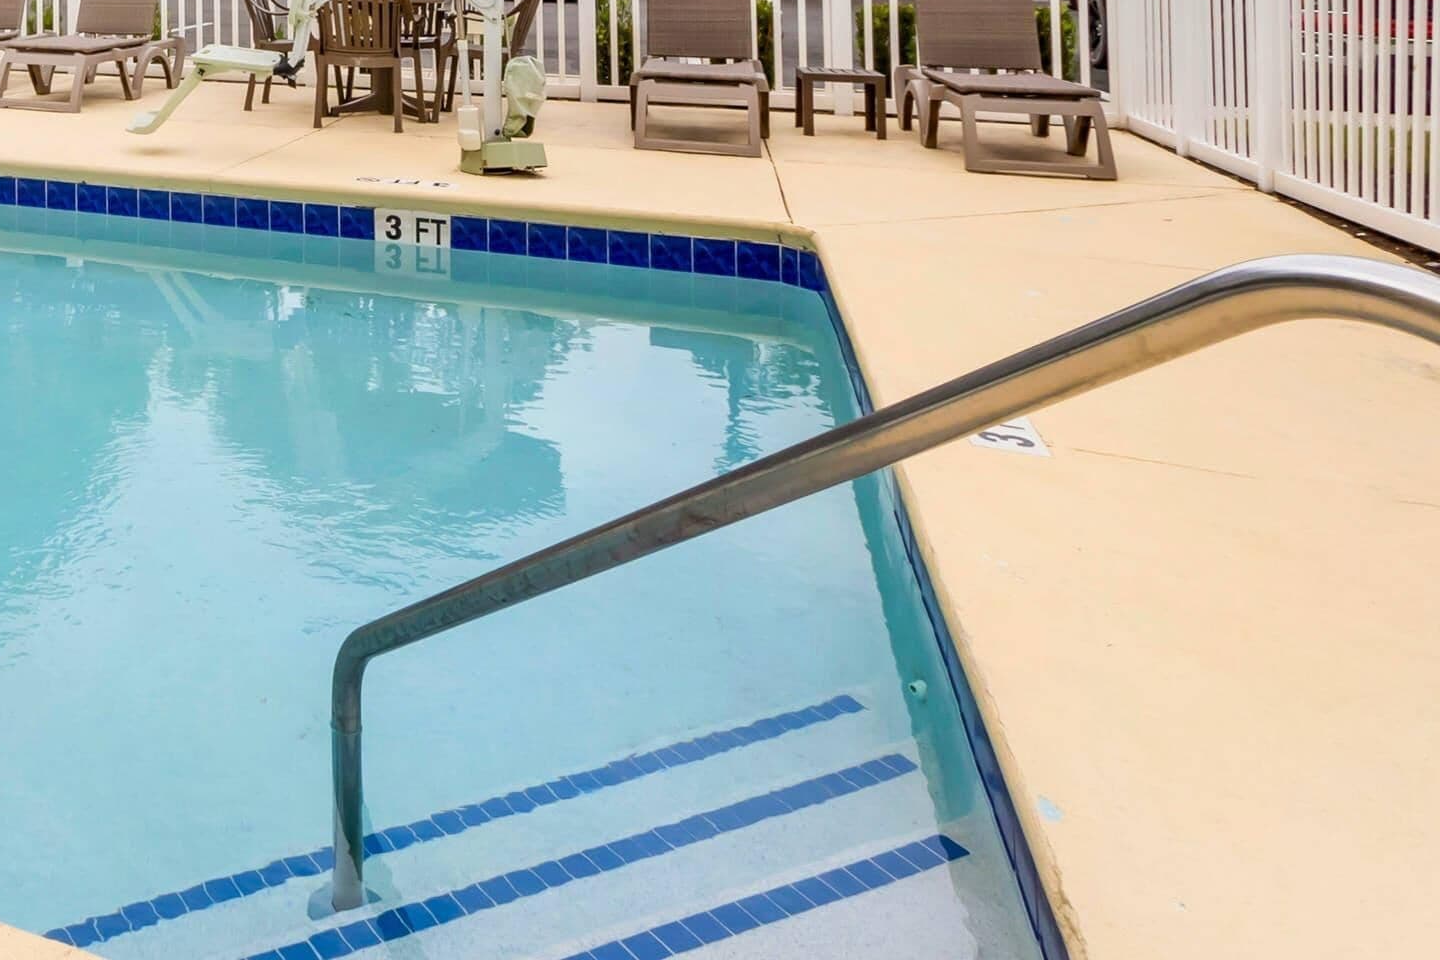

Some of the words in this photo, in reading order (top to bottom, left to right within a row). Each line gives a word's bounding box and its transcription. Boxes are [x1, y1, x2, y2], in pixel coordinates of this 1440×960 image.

[385, 215, 402, 240] 3
[415, 217, 447, 245] FT
[978, 431, 1035, 448] 3
